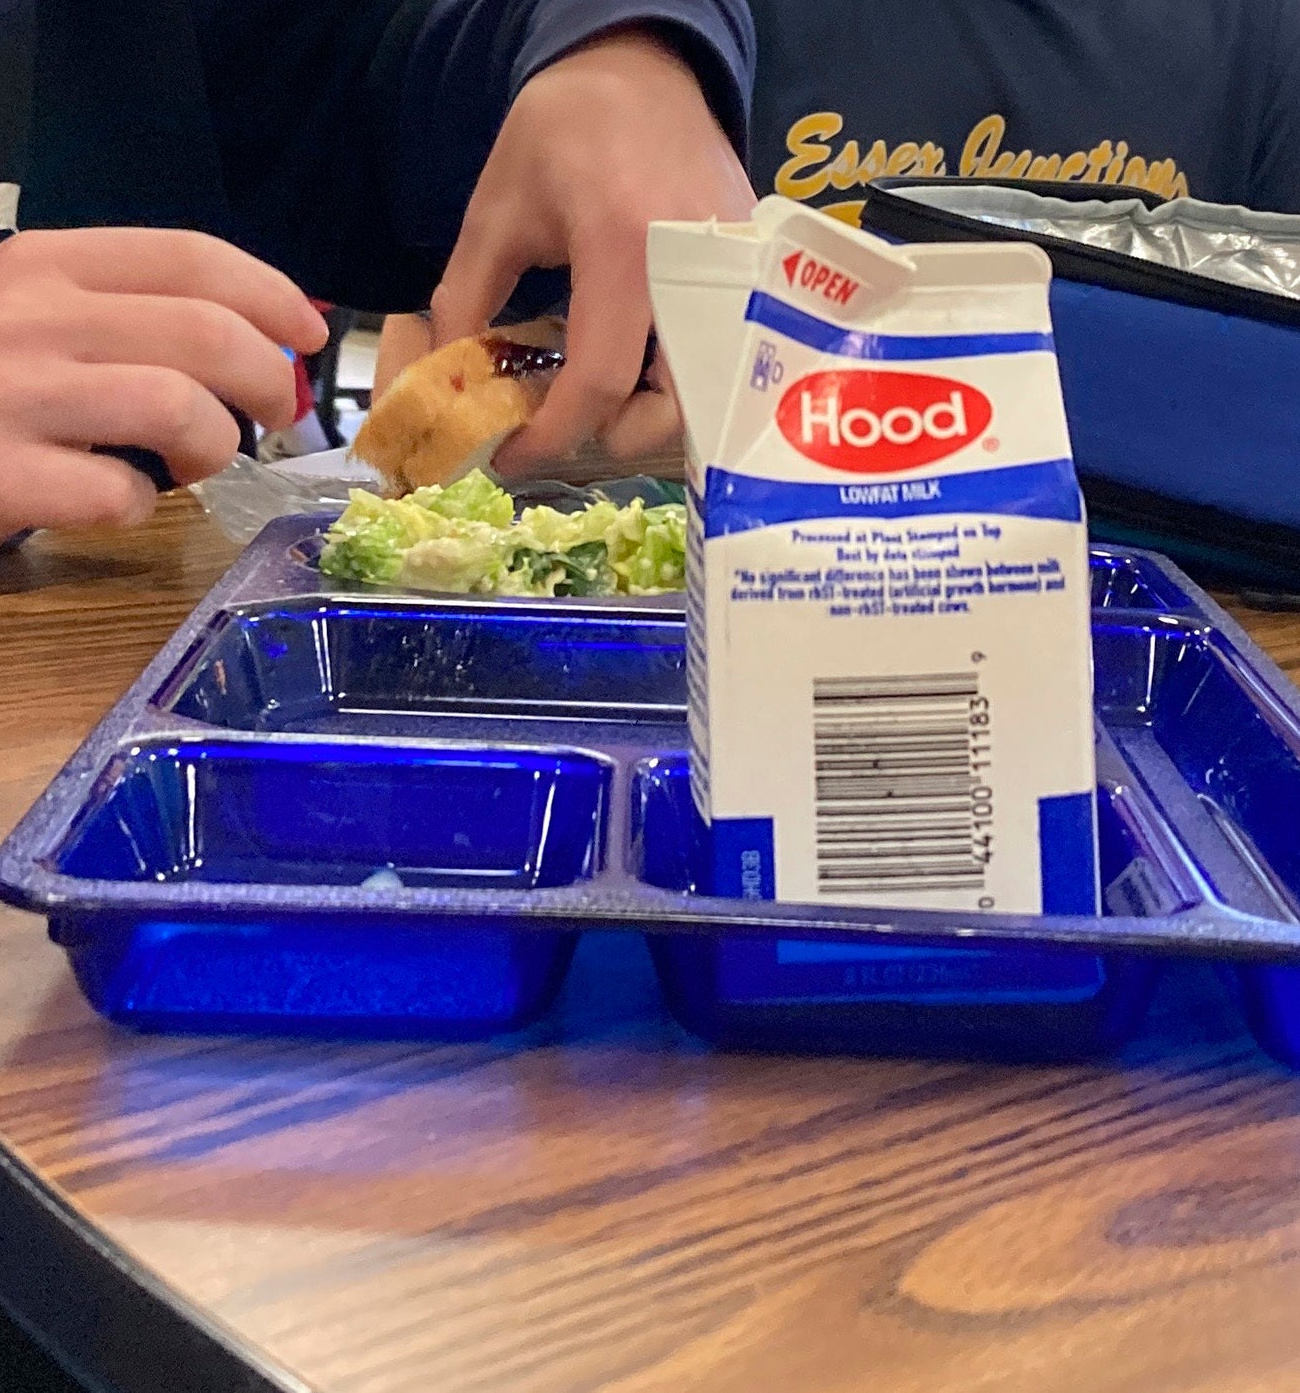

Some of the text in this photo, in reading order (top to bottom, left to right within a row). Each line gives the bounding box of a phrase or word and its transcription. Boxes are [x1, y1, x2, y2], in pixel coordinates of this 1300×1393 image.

[800, 259, 860, 305] OPEN
[801, 390, 968, 448] Hood
[839, 480, 941, 504] LOWFAT MILK
[792, 528, 850, 543] Processed
[856, 533, 867, 543] at
[872, 530, 902, 543] Plant
[760, 570, 821, 587] significant
[825, 568, 884, 583] difference
[985, 560, 1033, 576] between
[731, 587, 773, 602] derived
[778, 587, 805, 600] from
[969, 650, 995, 908] 0 44100 11183 9
